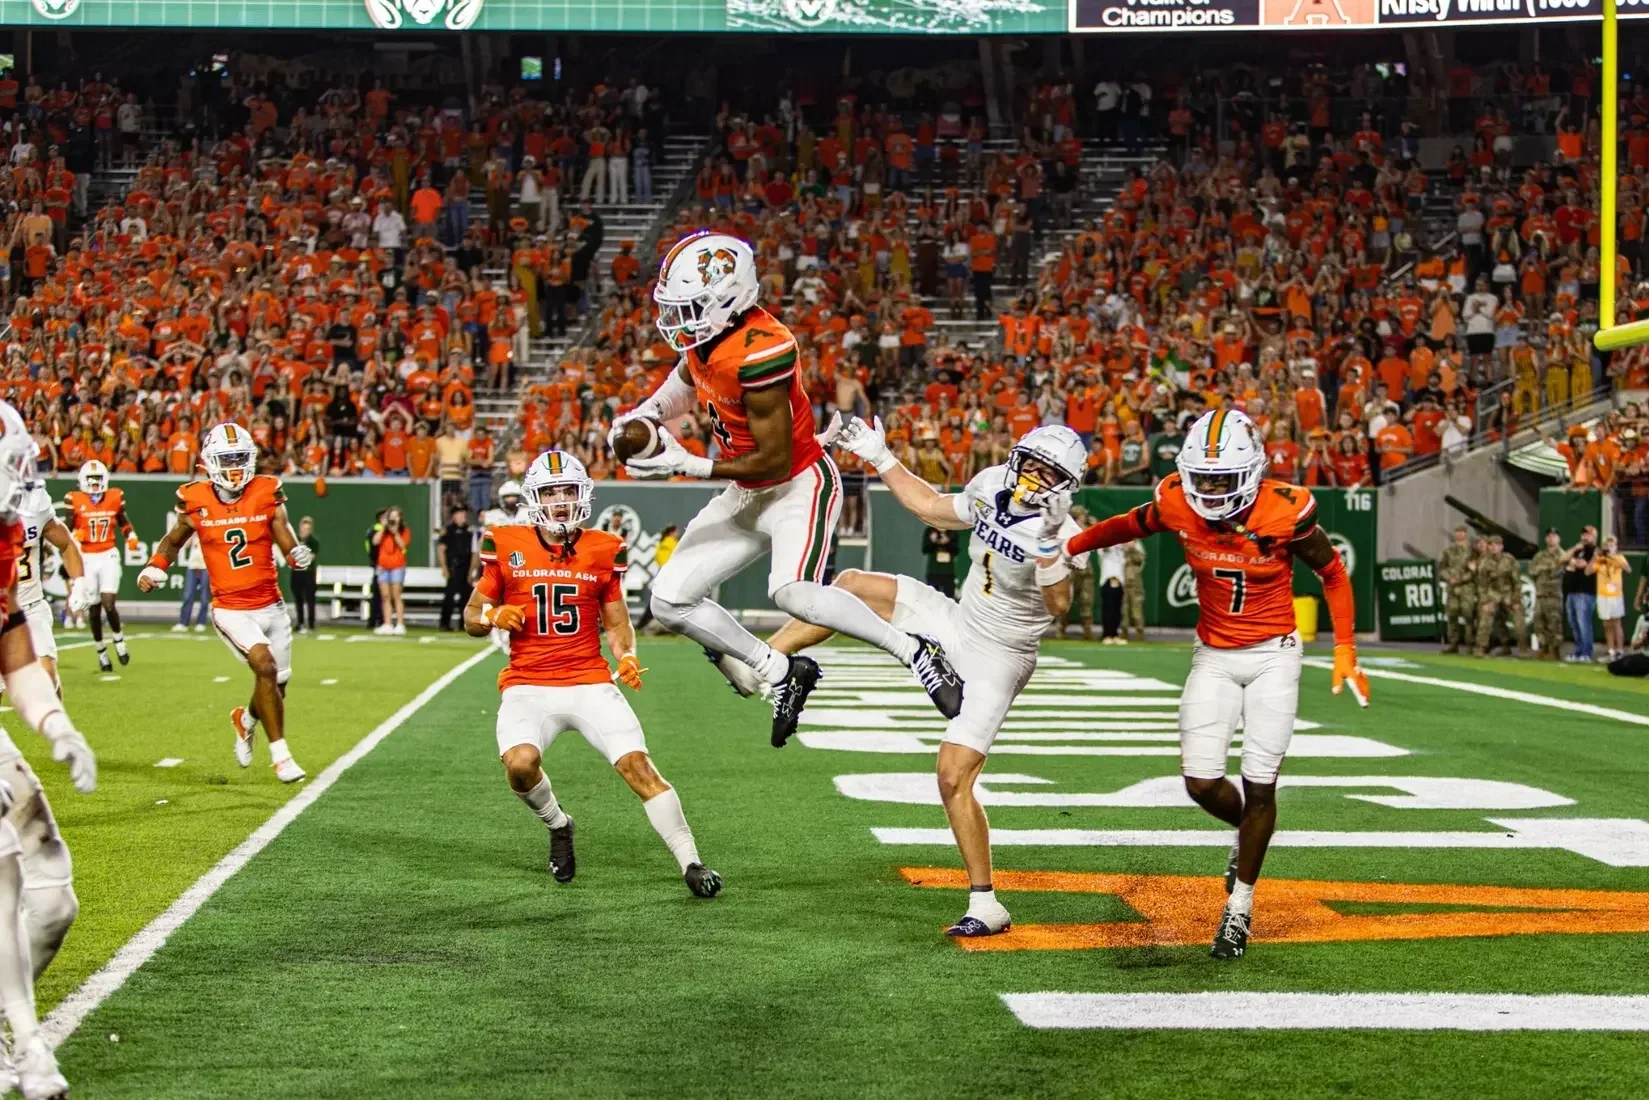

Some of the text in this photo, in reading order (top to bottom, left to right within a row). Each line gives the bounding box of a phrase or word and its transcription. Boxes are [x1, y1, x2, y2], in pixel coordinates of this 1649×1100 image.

[1102, 7, 1235, 26] Champions
[89, 517, 111, 543] 17
[224, 527, 253, 570] 2
[512, 569, 598, 583] COLORADO A&M
[1213, 567, 1247, 615] 7
[532, 583, 580, 636] 15
